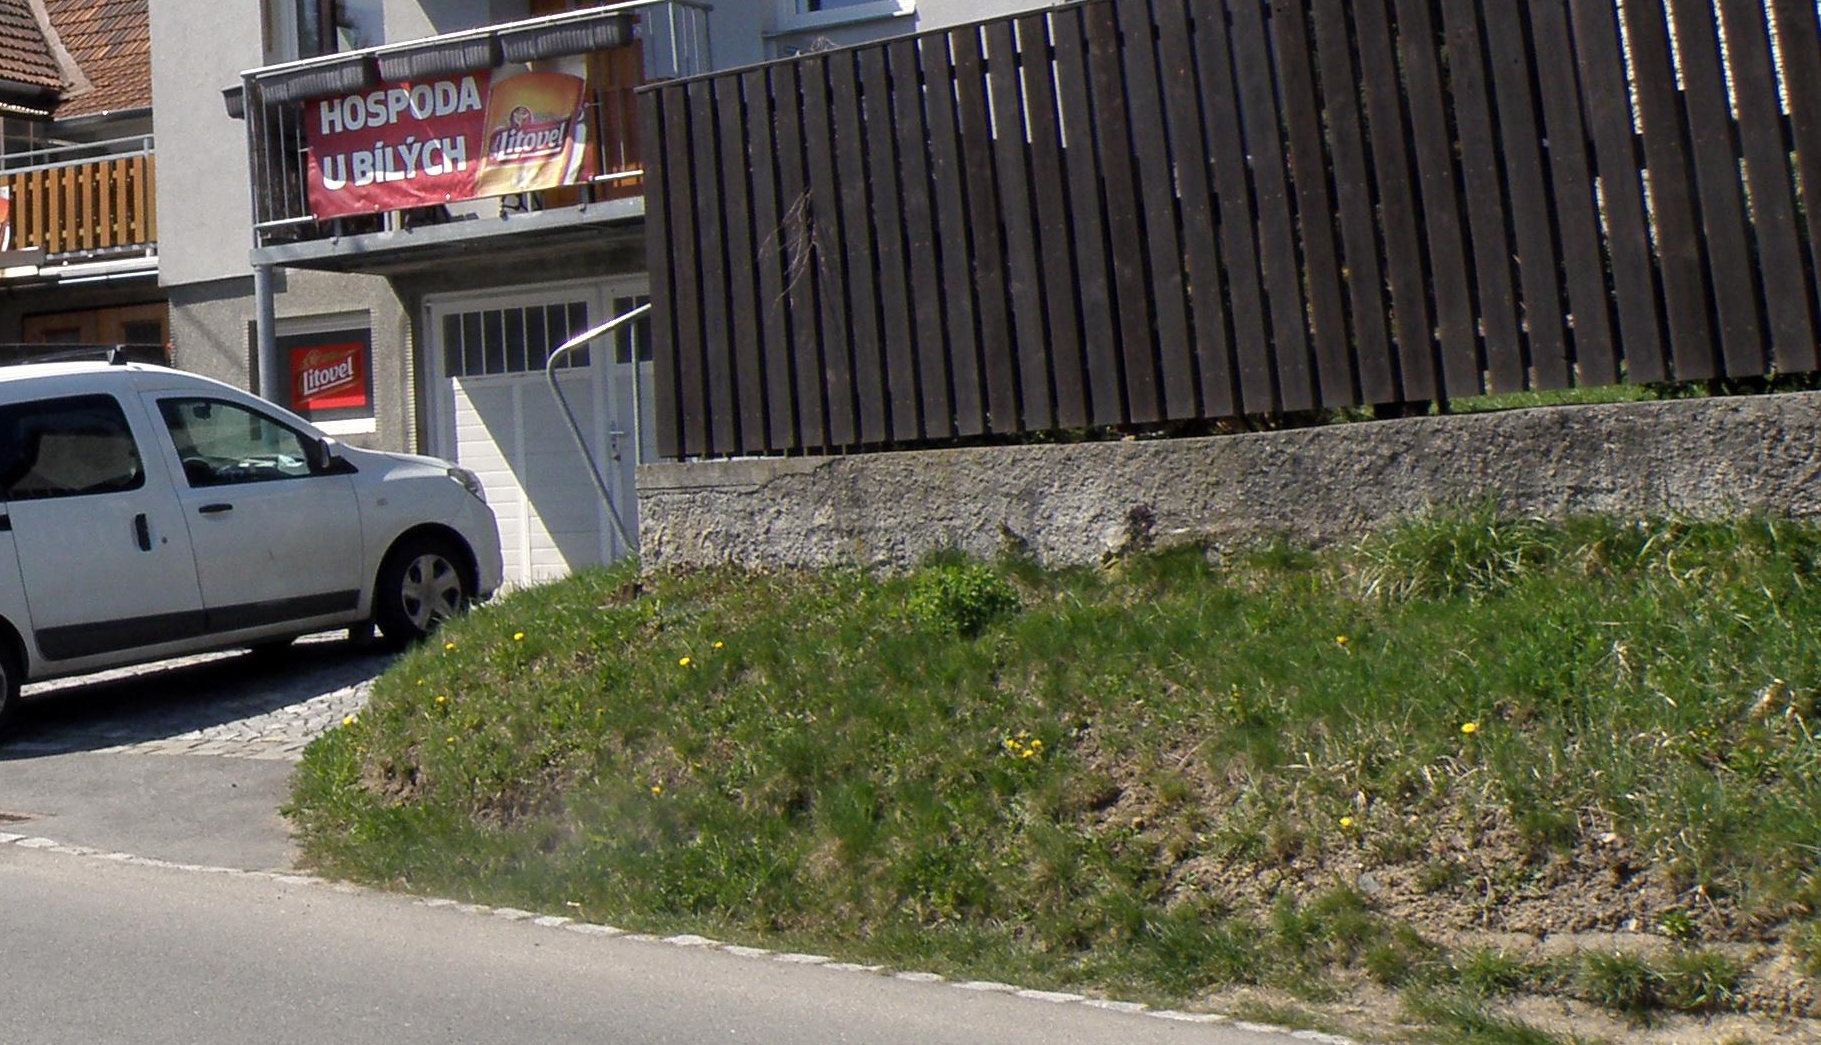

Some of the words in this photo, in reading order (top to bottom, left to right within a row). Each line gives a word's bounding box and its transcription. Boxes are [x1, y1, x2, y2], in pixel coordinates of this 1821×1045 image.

[320, 76, 482, 134] HOSPODA
[323, 154, 346, 190] U
[352, 136, 467, 187] BÍLÝCH
[496, 122, 566, 162] Litovel
[303, 355, 354, 396] Litovel
